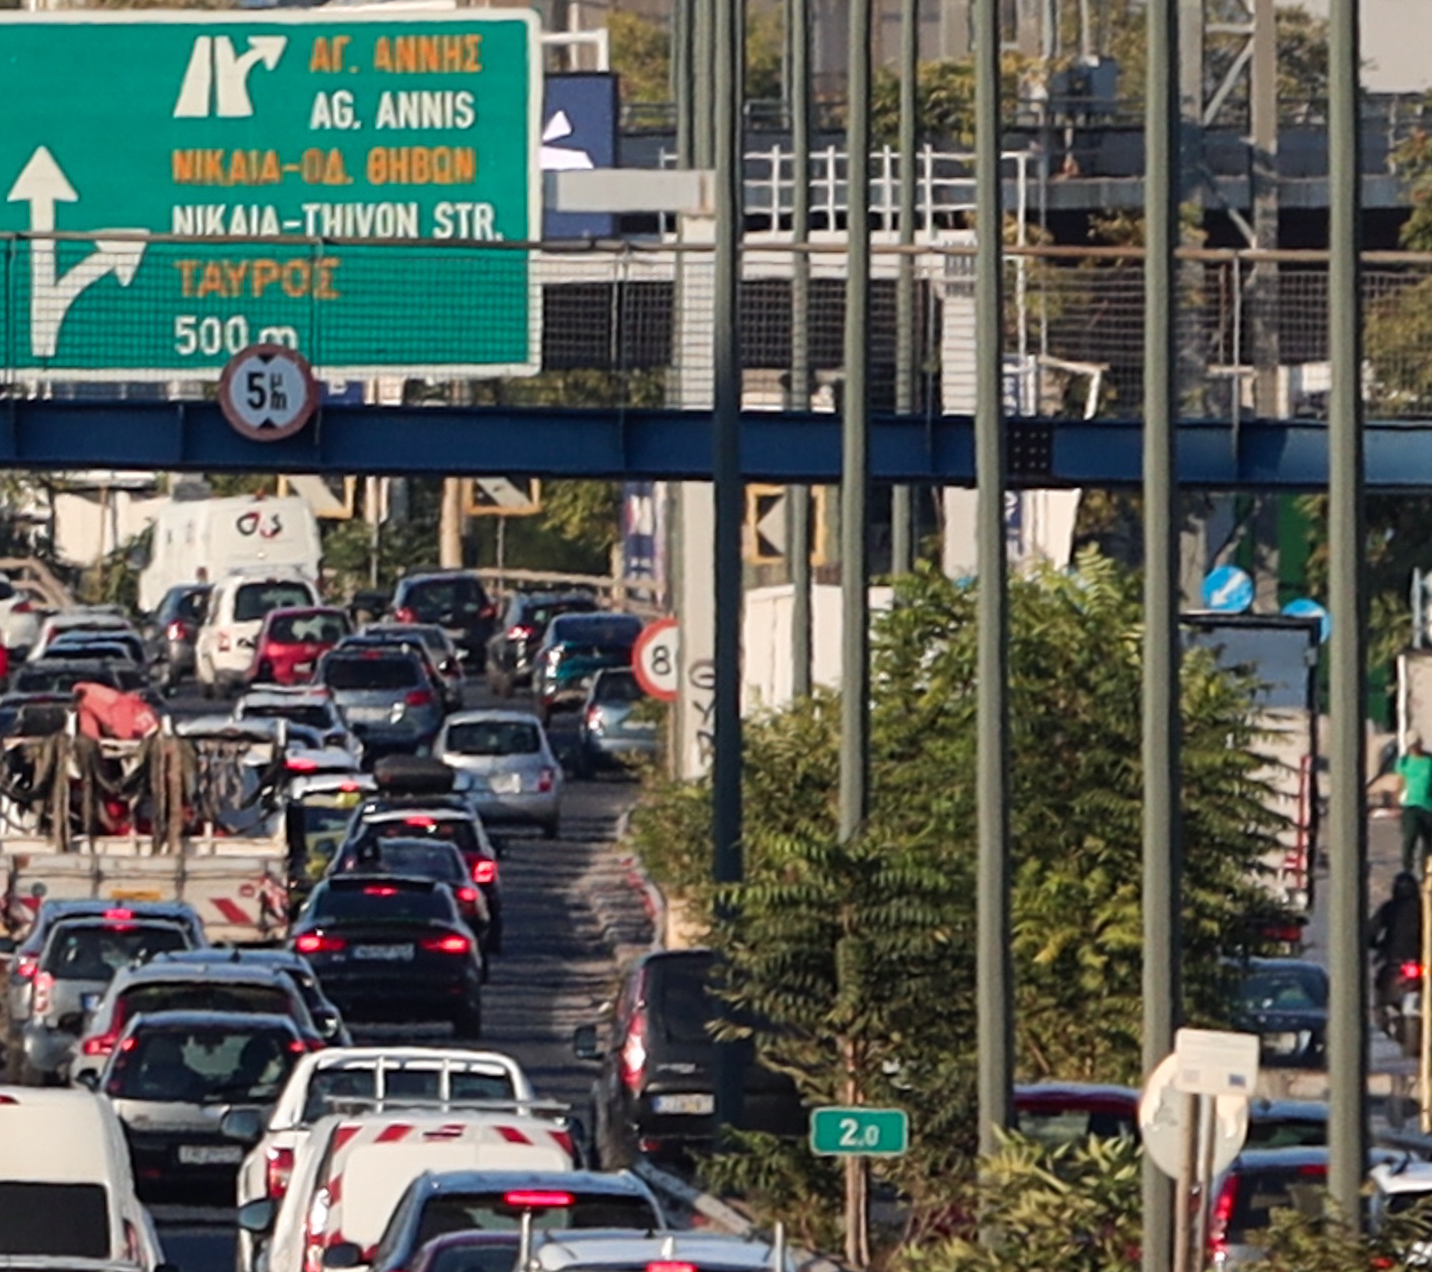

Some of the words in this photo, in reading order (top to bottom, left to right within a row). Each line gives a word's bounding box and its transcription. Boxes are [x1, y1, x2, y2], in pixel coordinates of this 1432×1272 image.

[309, 35, 360, 73] ΑΓ.
[374, 34, 483, 73] ΑΝΝΗΣ
[375, 91, 476, 130] ANNIS
[367, 147, 477, 184] ΘΗΒΩΝ
[432, 203, 505, 242] STR.
[174, 257, 342, 301] ΤΑΥΡΟΣ
[174, 314, 249, 355] 500
[246, 371, 267, 412] 5
[838, 1117, 880, 1147] 2.0
